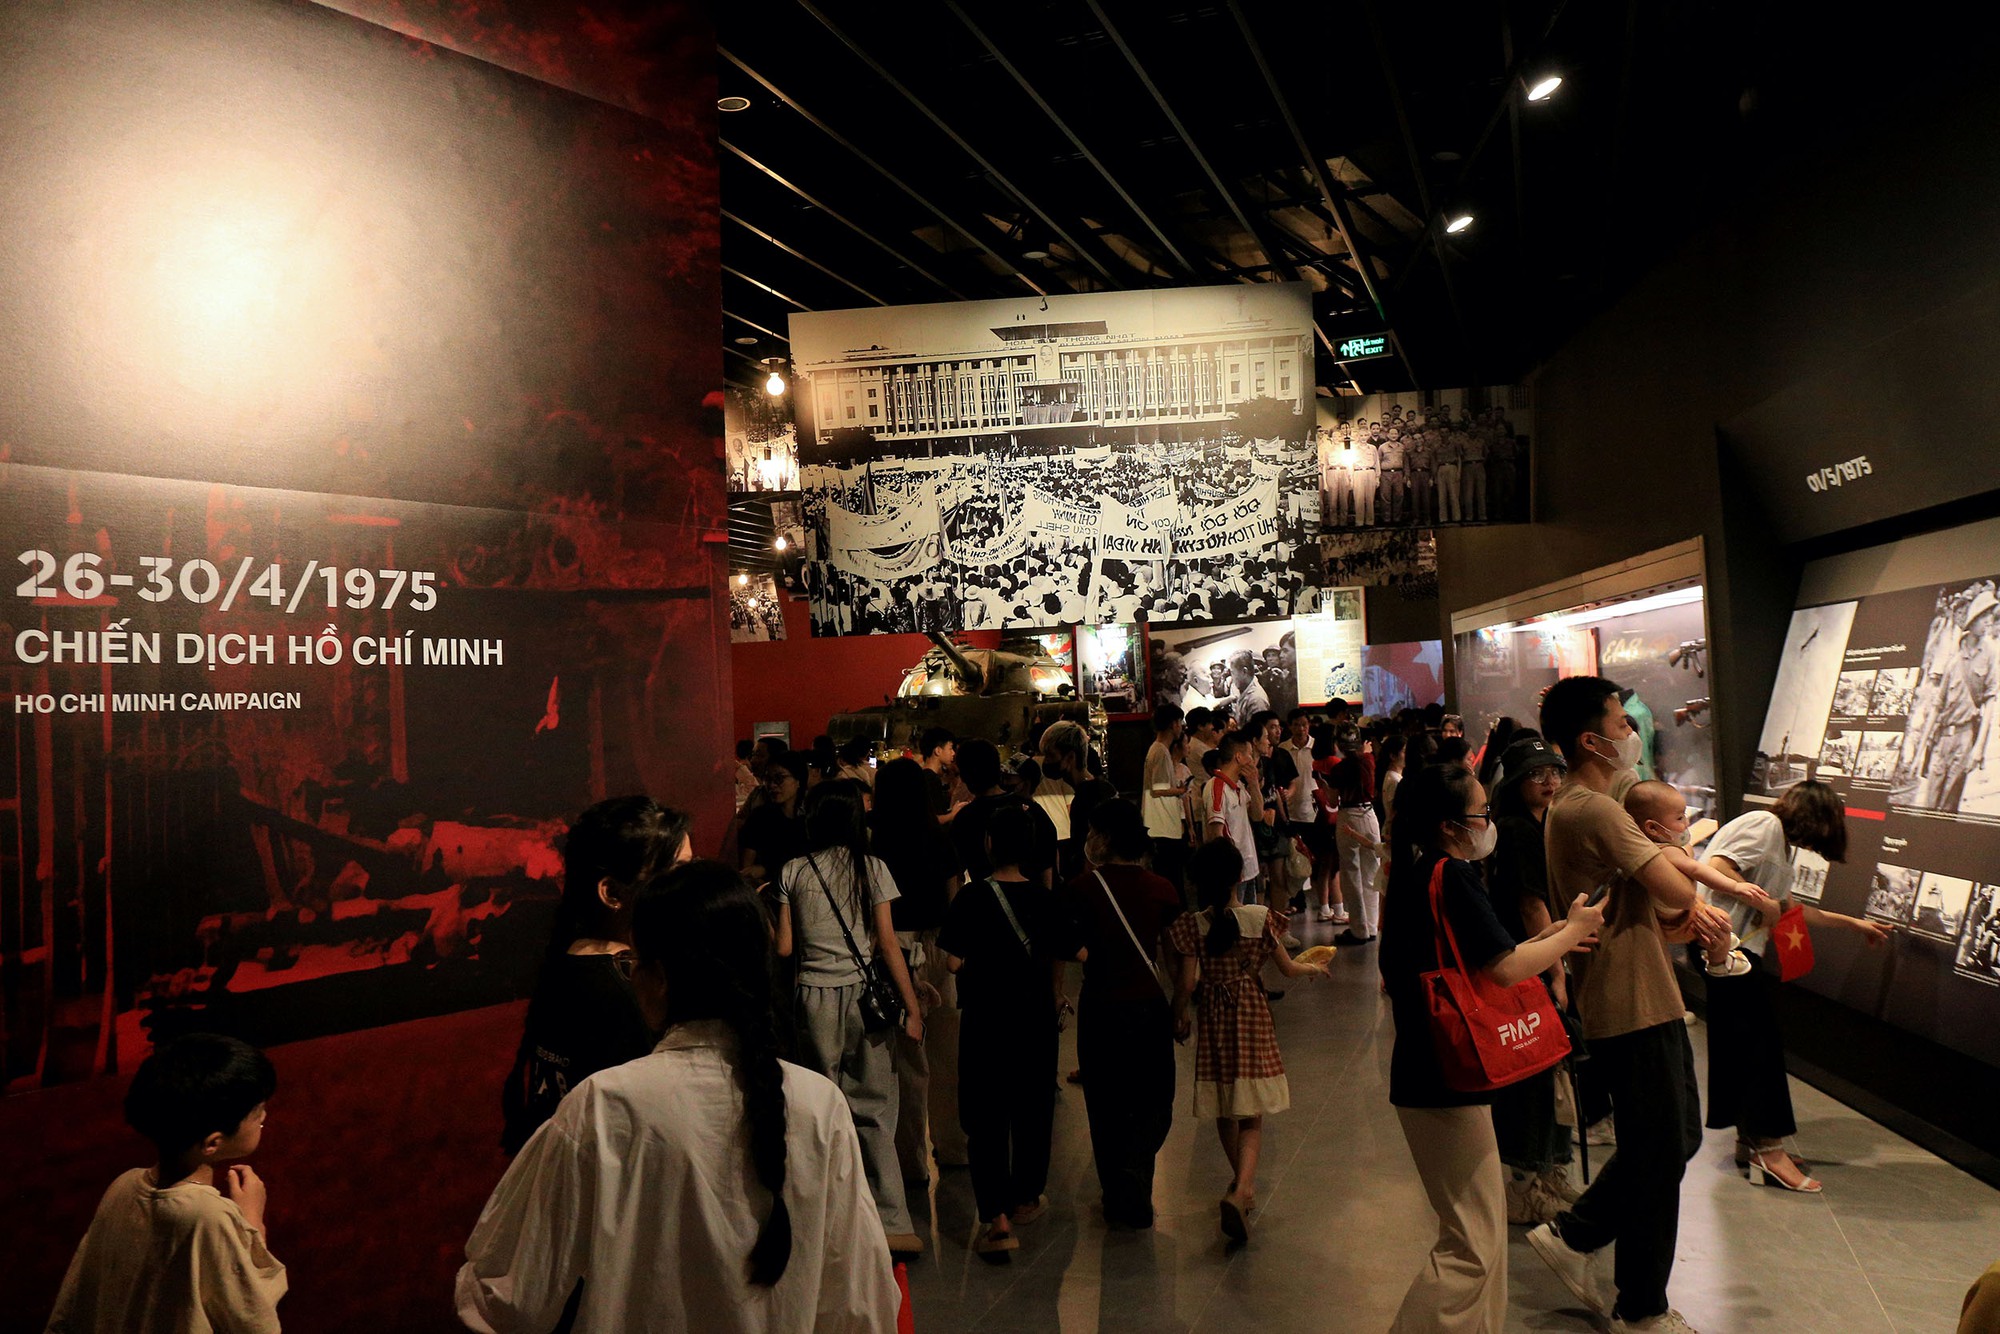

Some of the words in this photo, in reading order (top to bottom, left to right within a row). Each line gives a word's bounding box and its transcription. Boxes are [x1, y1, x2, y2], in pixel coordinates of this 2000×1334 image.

[1365, 346, 1384, 355] EXIT
[1806, 455, 1873, 493] 01/5/1975
[16, 549, 438, 613] 26-30/4/1975
[14, 618, 162, 665] CHIẾN
[176, 632, 275, 671] DỊCH
[287, 623, 343, 666] HỒ
[352, 630, 413, 666] CHÍ
[422, 637, 504, 666] MINH
[14, 694, 56, 714] HO
[59, 693, 105, 713] CHI
[112, 692, 176, 712] MINH
[180, 692, 302, 712] CAMPAIGN
[1497, 1012, 1541, 1047] FMP
